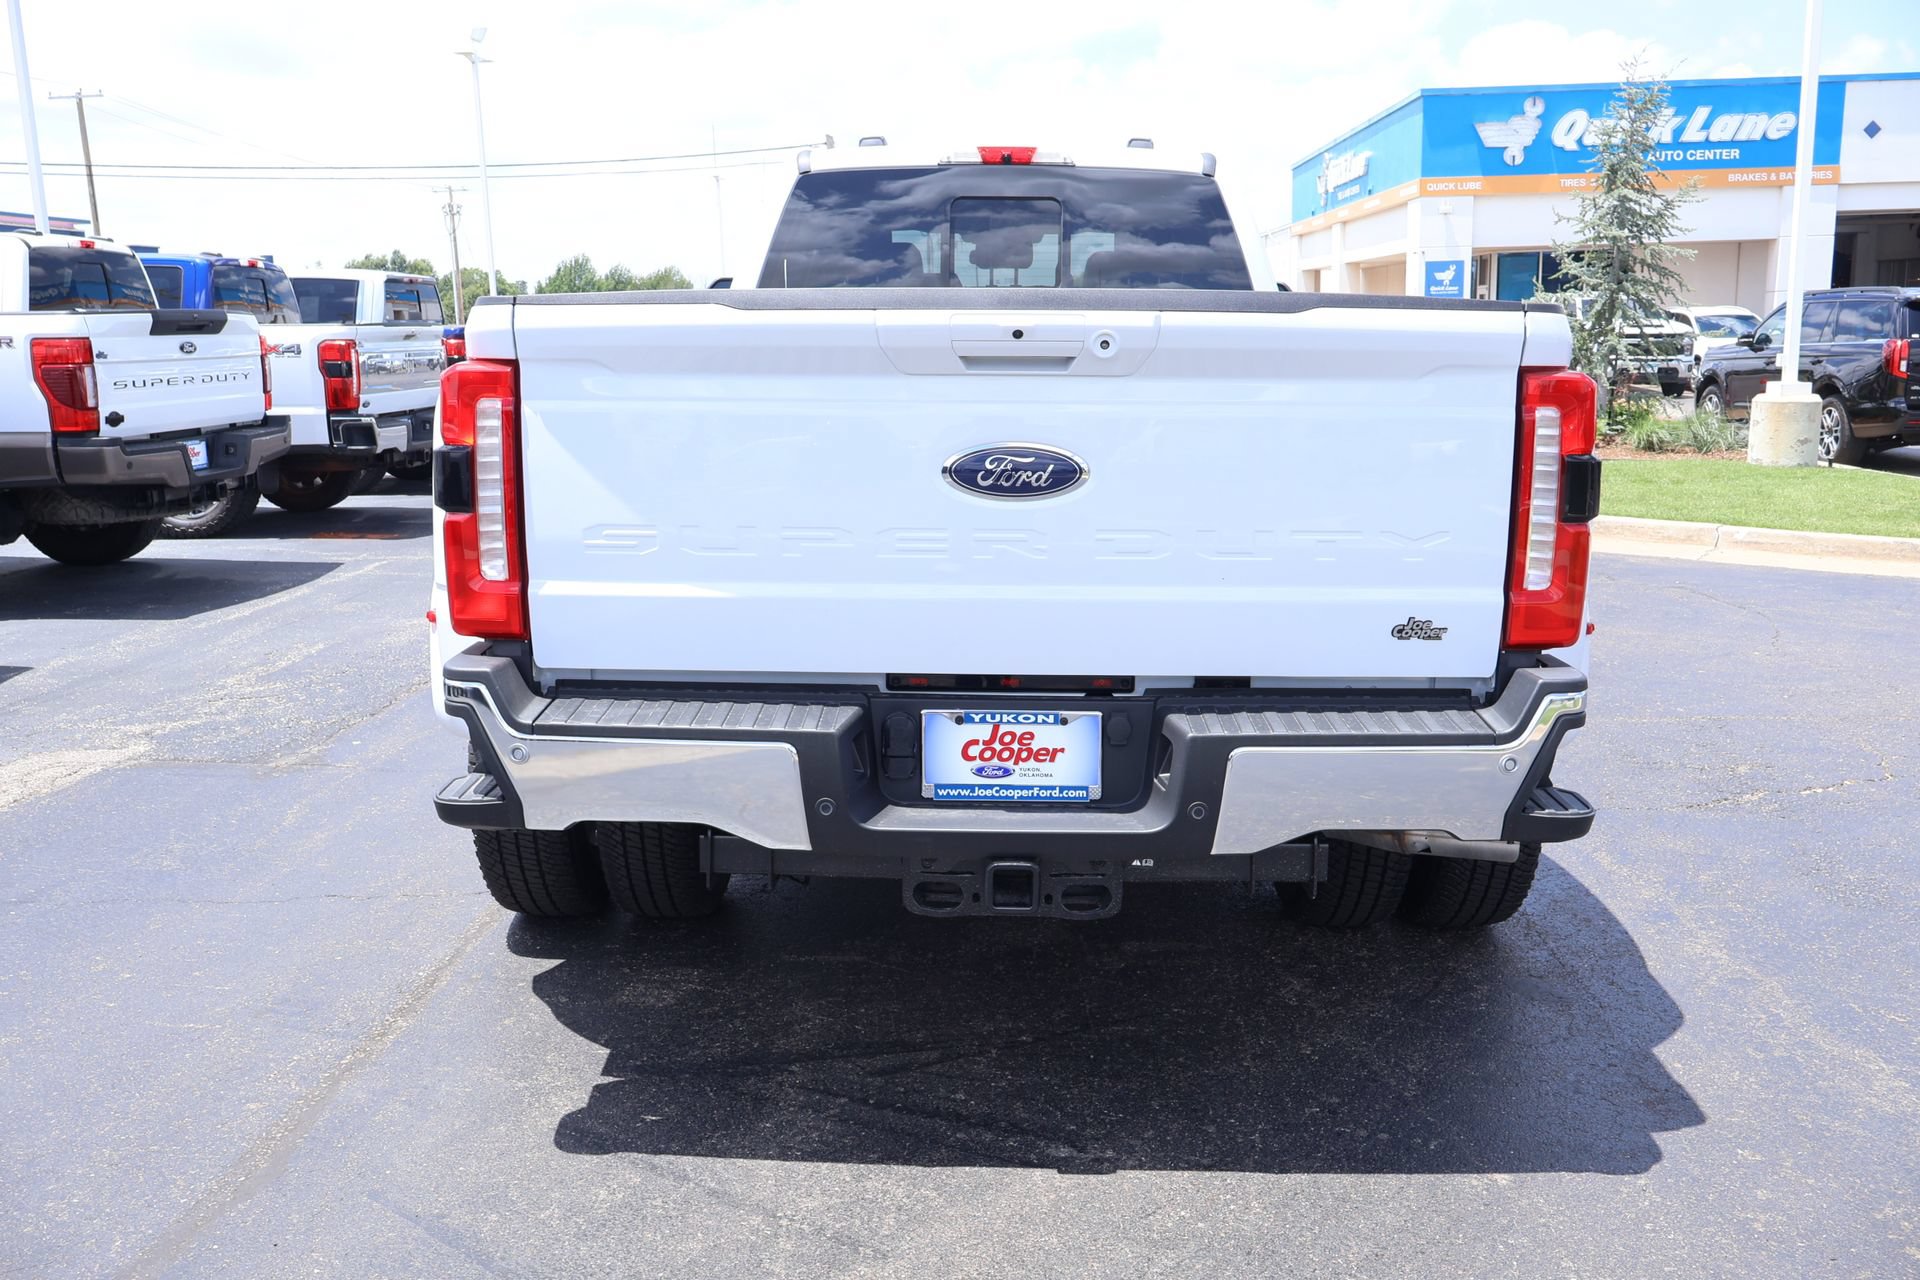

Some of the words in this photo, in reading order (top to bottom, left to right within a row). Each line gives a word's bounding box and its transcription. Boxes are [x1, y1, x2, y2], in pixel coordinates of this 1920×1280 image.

[1551, 106, 1687, 151] Quk
[1679, 105, 1798, 143] Lane
[1647, 149, 1683, 162] AUTO
[1686, 148, 1740, 161] CENTER
[1560, 177, 1586, 188] TIRES
[1727, 173, 1767, 183] BRAKES
[1770, 172, 1777, 182] &
[1779, 170, 1833, 182] BARIES
[1427, 183, 1455, 191] QUICK
[1457, 181, 1482, 191] LUBE
[113, 375, 195, 390] SUPER
[201, 371, 250, 383] DUTY
[976, 454, 1055, 488] Ford
[582, 522, 1048, 560] SUPER
[1095, 528, 1452, 561] DUTY
[1404, 616, 1433, 630] Joe
[1391, 624, 1449, 639] Cooper
[969, 713, 1055, 724] YUKON
[982, 723, 1035, 747] Joe
[960, 738, 1065, 766] Cooper
[936, 786, 1088, 800] www.JoeCooperFord.com
